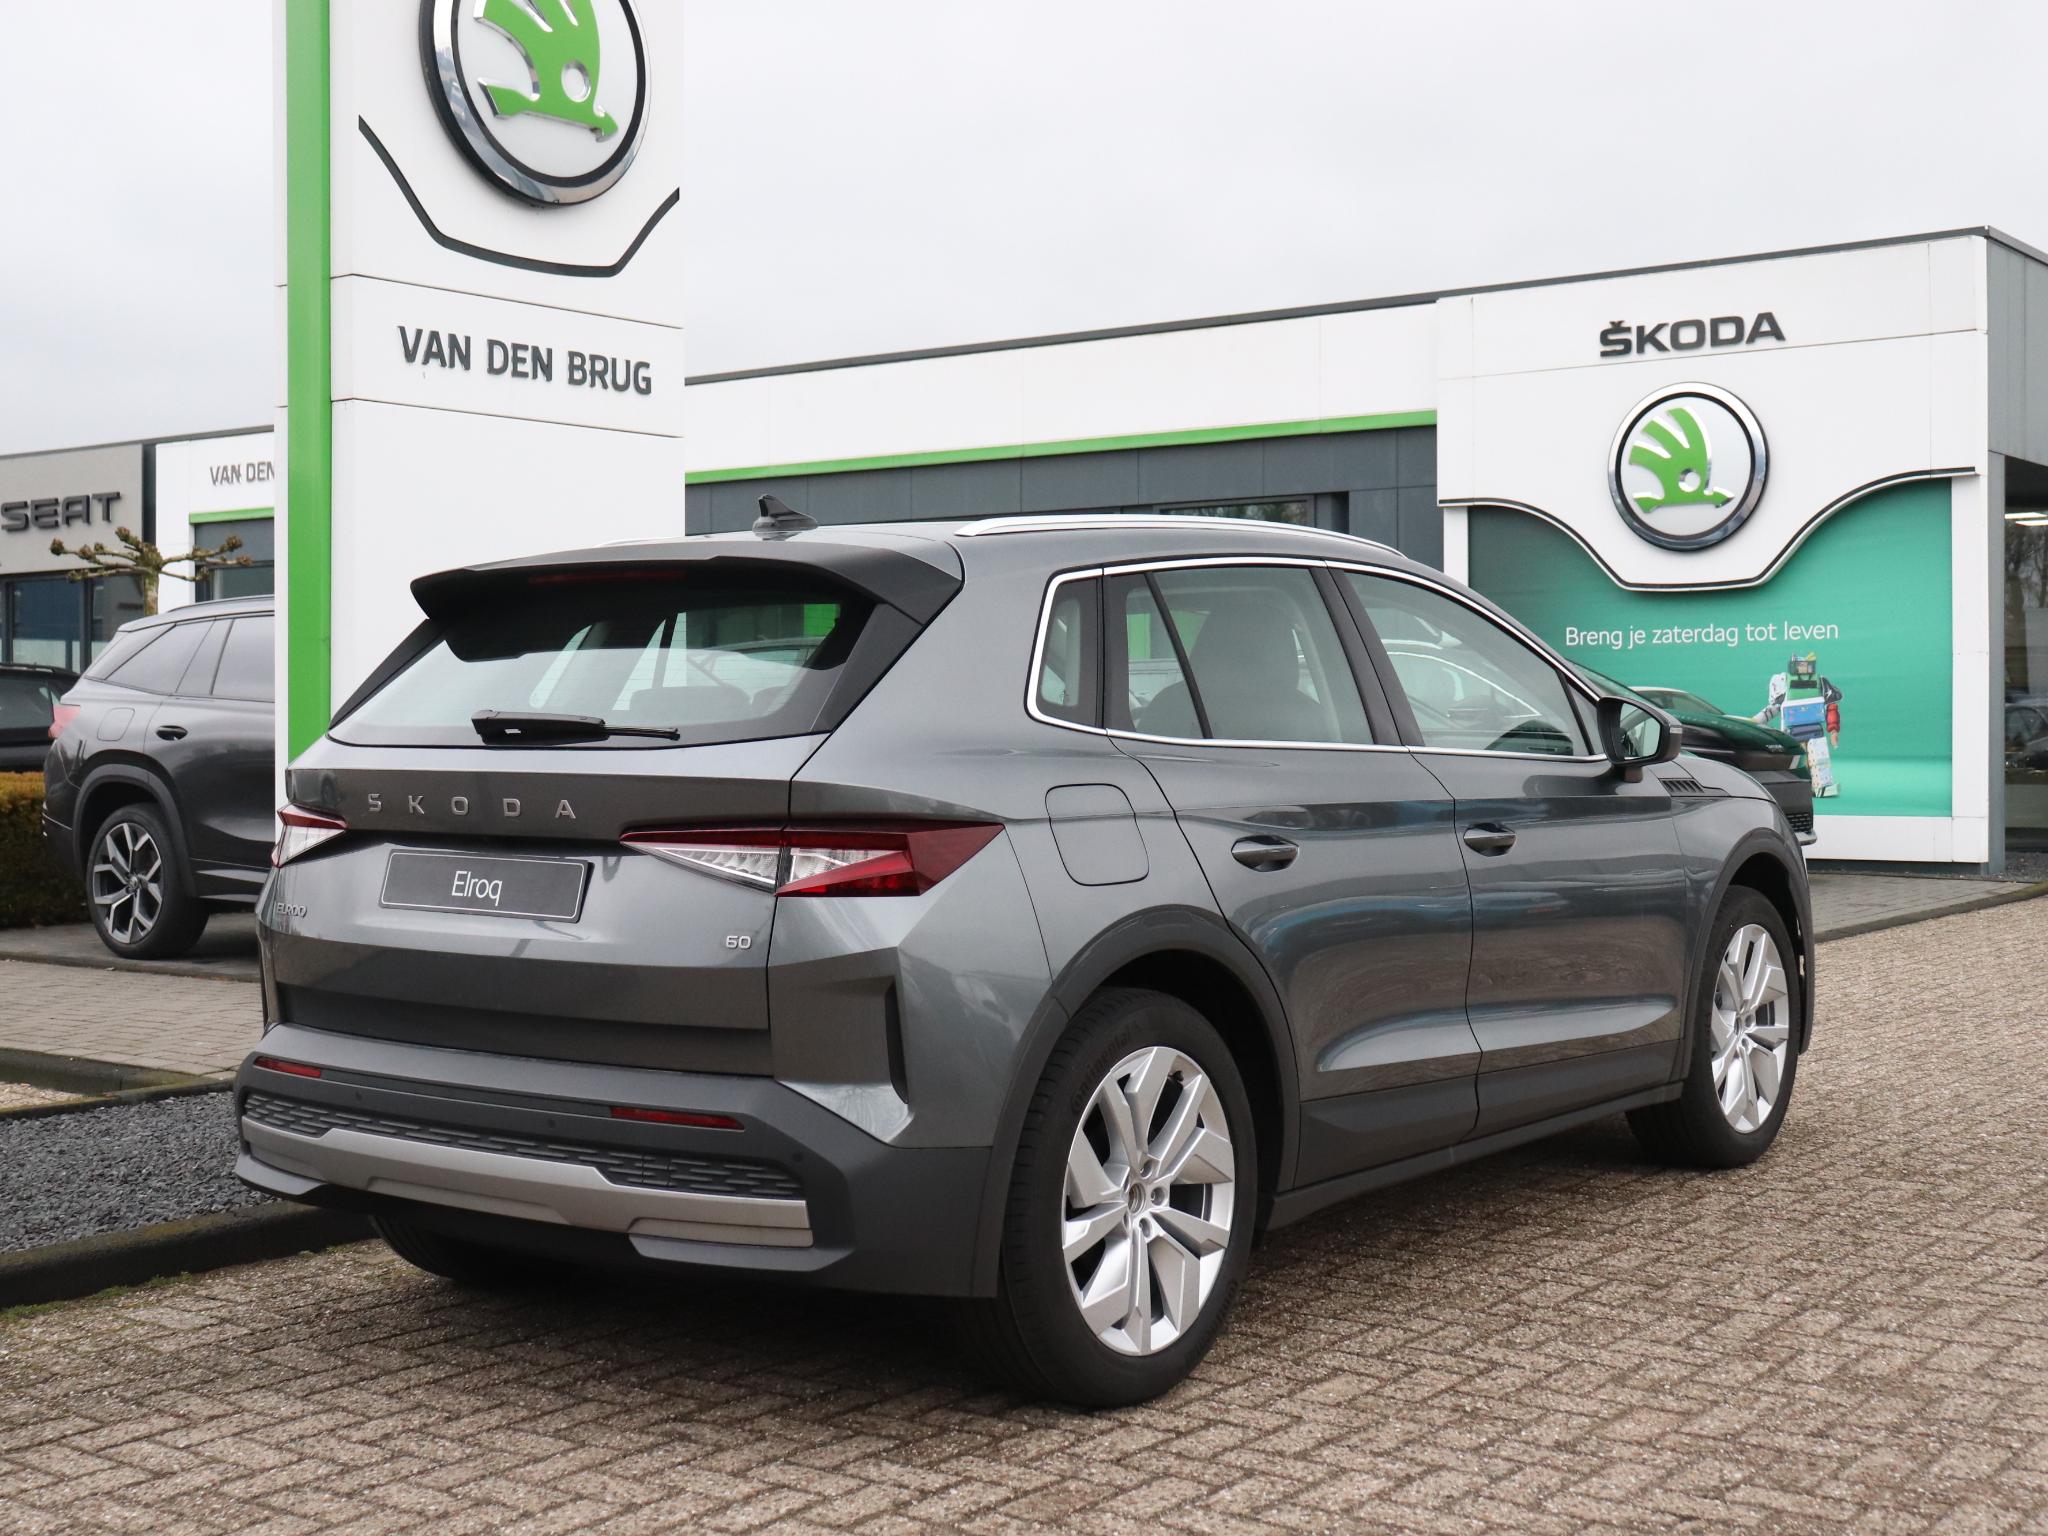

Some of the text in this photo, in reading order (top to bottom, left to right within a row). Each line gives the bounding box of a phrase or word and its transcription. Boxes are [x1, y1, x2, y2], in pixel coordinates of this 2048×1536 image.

[1599, 311, 1786, 358] ŠKODA
[397, 325, 652, 395] VAN DEN BRUG
[209, 464, 242, 486] VAN
[0, 491, 121, 532] SEAT
[1565, 621, 1839, 649] Breng je zaterdag tot leven
[451, 870, 503, 907] Elroq
[725, 935, 751, 949] 60
